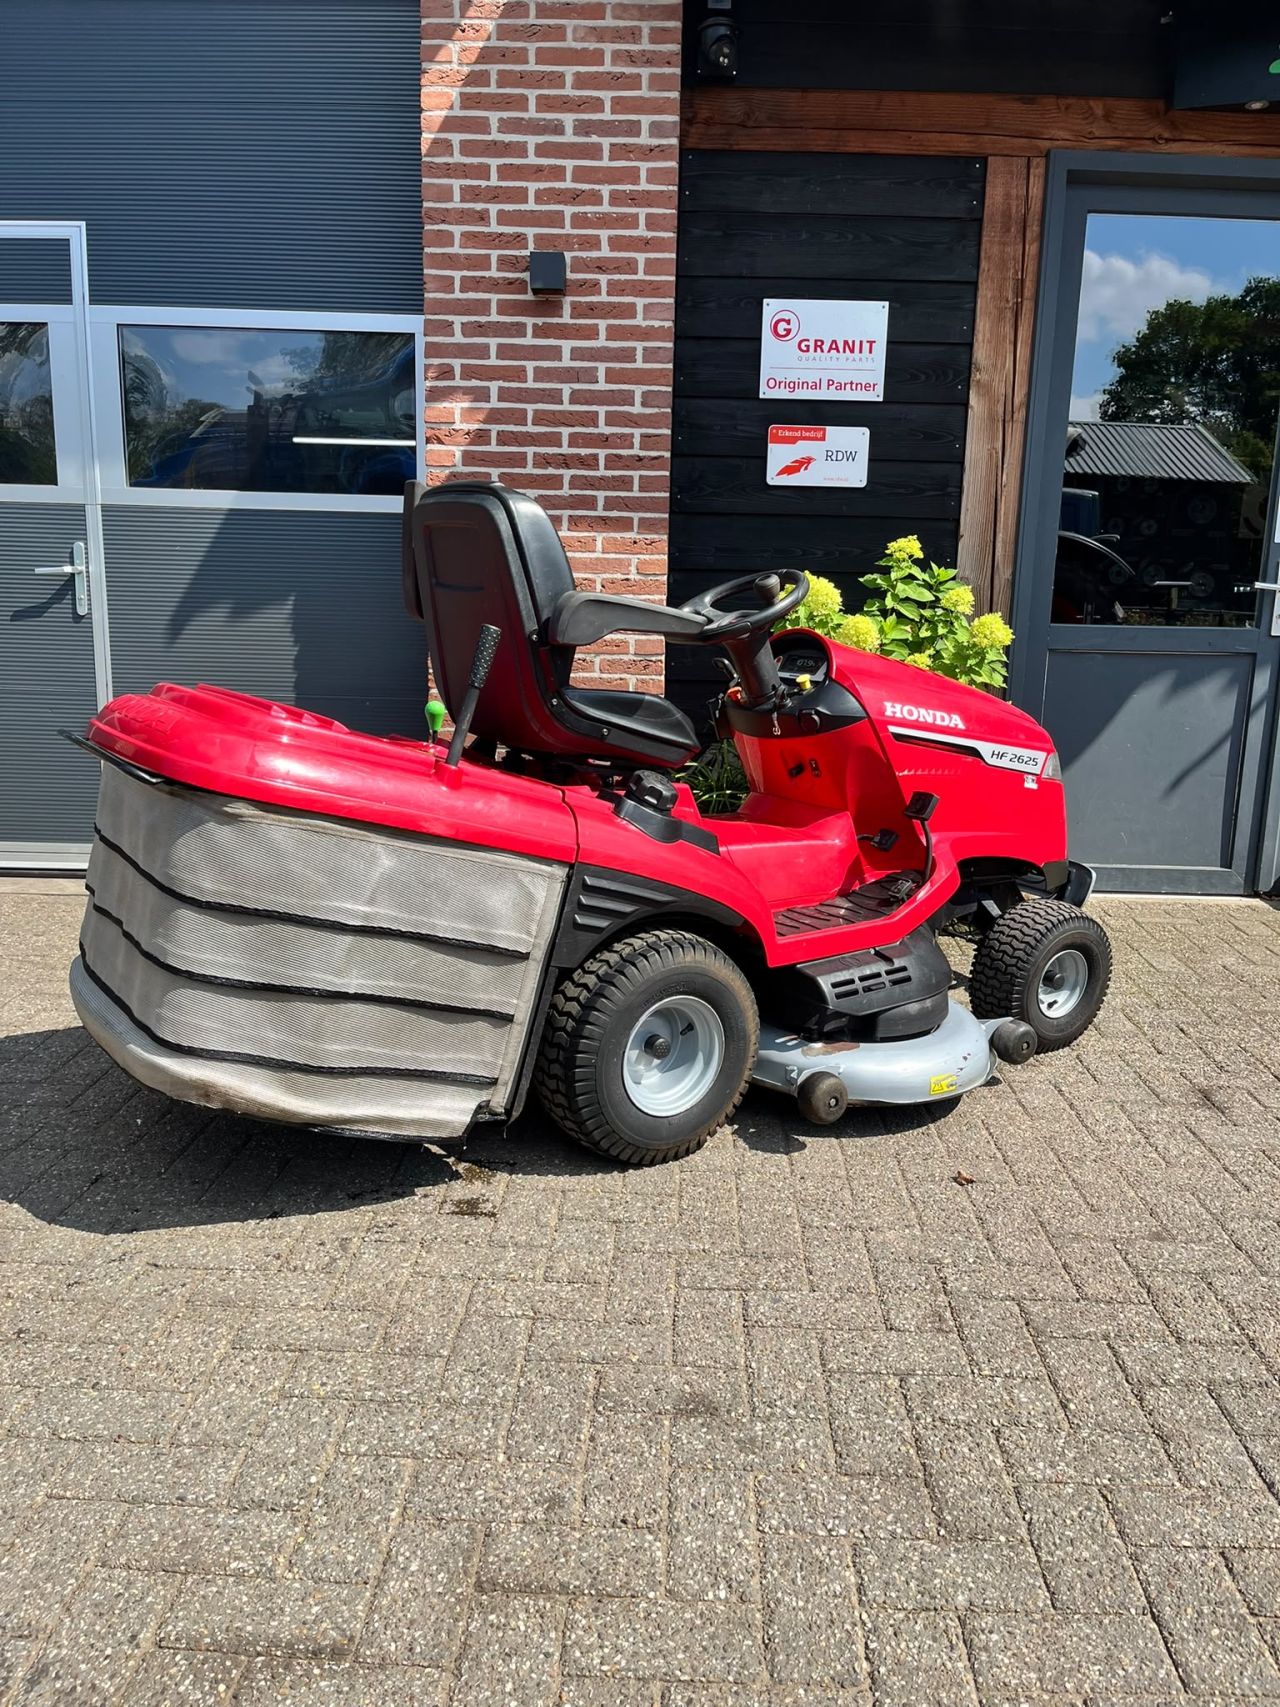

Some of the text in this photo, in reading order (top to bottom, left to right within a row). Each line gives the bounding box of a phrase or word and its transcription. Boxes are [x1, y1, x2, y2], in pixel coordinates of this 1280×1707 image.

[797, 338, 877, 355] GRANIT
[766, 377, 878, 393] Original Partner
[778, 429, 823, 439] Erkend bedrijf
[825, 449, 858, 462] RDW
[883, 701, 966, 730] HONDA
[1009, 753, 1039, 767] 2625
